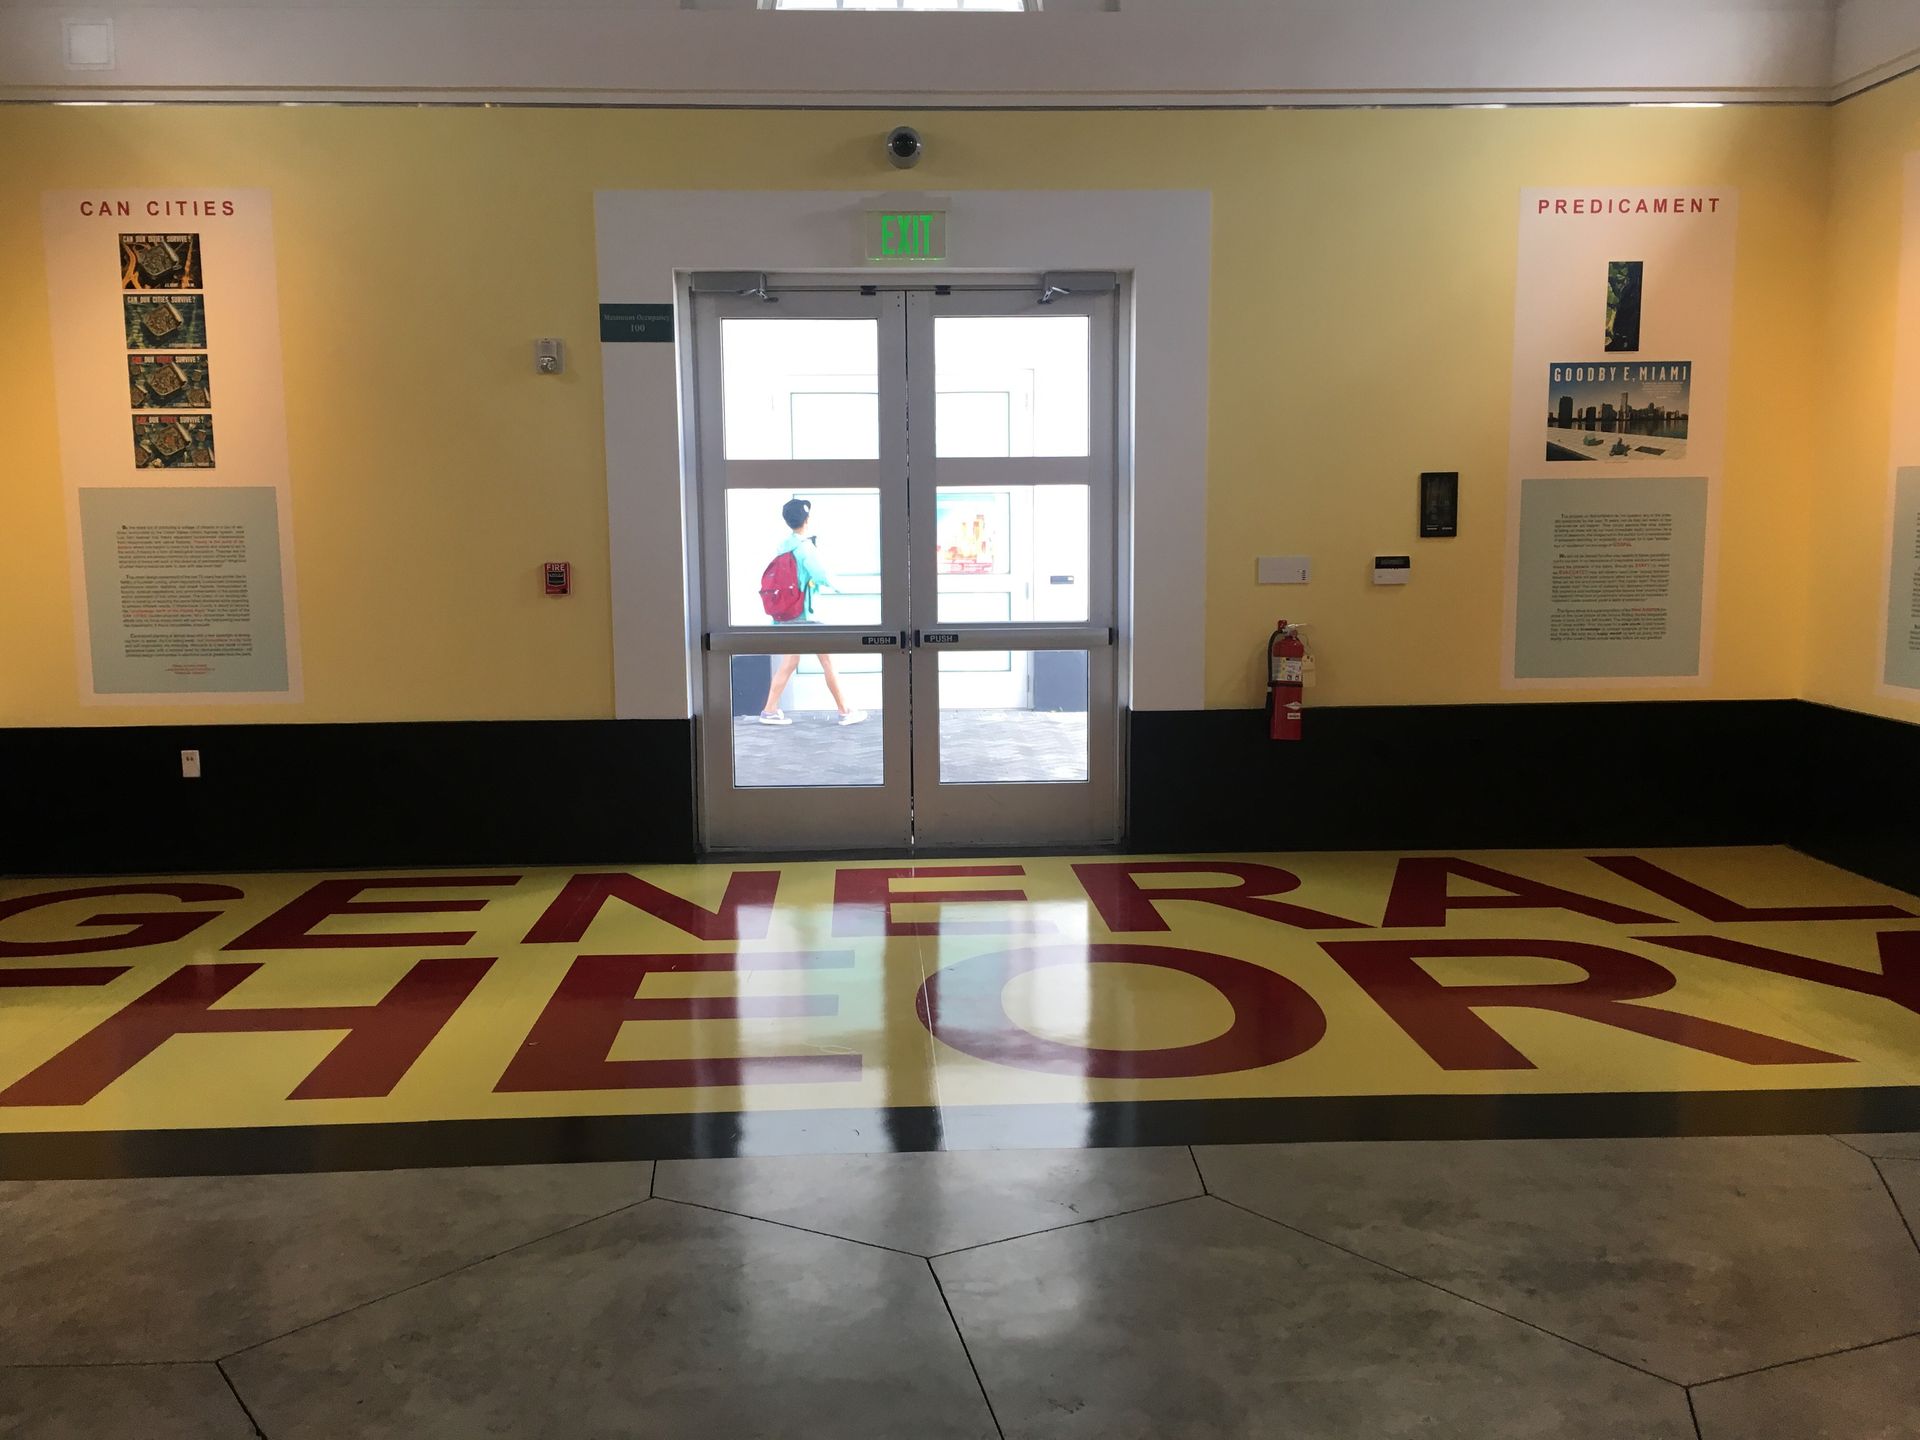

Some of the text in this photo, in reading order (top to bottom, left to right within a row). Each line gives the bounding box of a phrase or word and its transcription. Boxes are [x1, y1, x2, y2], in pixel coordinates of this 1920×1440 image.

[80, 201, 235, 216] CAN CITIES
[1538, 198, 1720, 214] PREDICAMENT
[881, 215, 933, 255] EXIT
[630, 324, 646, 332] 100
[1640, 366, 1687, 381] MIAMI
[546, 563, 566, 571] FIRE
[0, 863, 1920, 957] GENERAL
